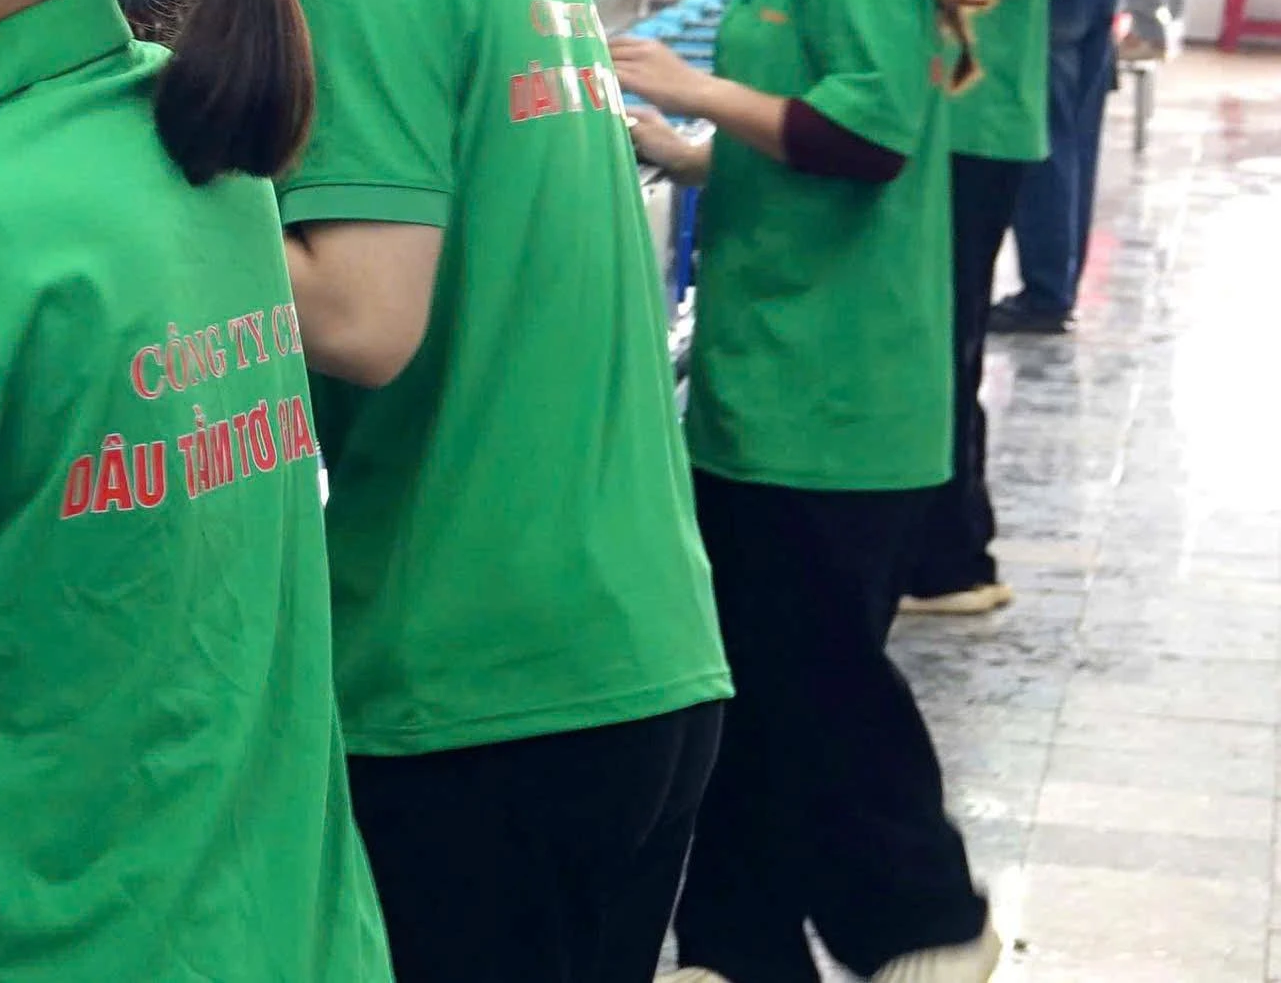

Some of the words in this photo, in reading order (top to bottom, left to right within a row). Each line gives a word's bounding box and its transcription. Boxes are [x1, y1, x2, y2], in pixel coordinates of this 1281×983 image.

[130, 321, 227, 400] CÔNG
[228, 311, 269, 370] TY
[60, 432, 167, 520] DÂU
[232, 399, 278, 478] TƠ
